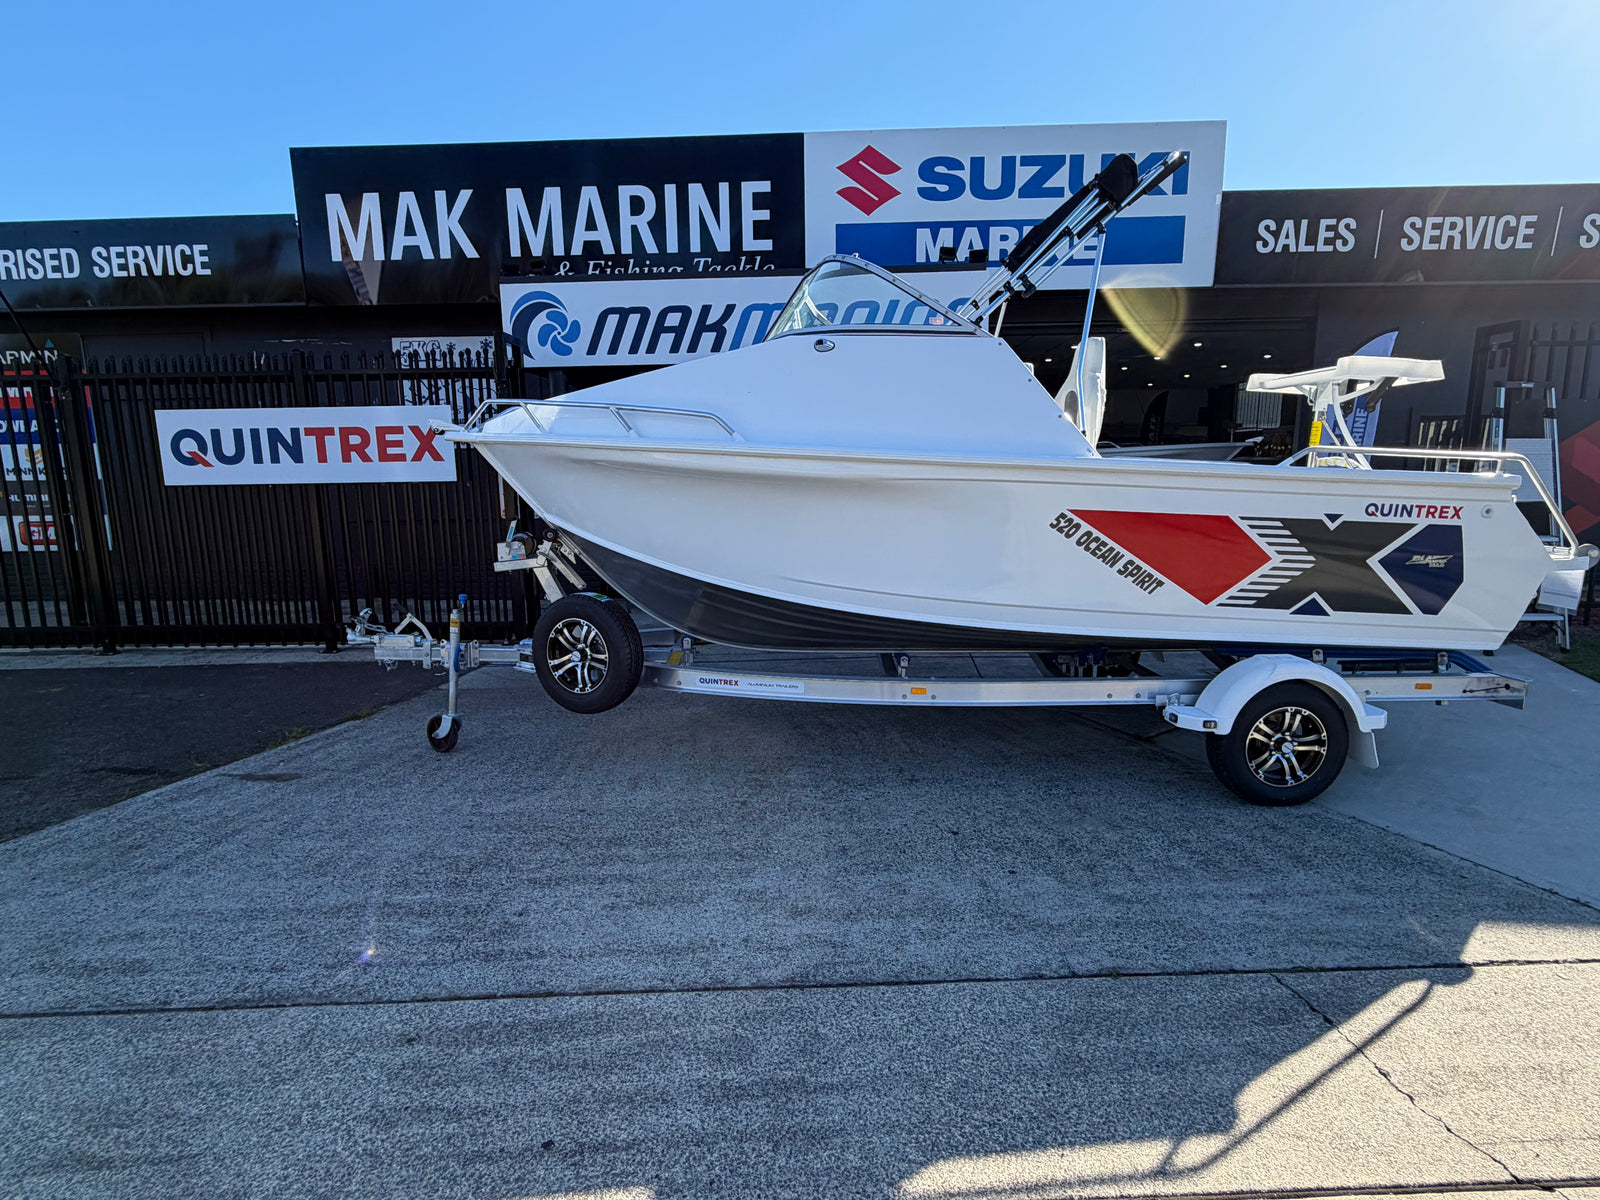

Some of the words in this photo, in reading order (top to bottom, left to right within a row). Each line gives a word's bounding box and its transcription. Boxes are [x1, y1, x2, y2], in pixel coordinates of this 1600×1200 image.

[325, 189, 480, 263] MAK
[505, 180, 774, 258] MARINE
[1255, 217, 1357, 254] SALES
[1400, 215, 1538, 252] SERVICE
[92, 244, 212, 279] SERVICE
[915, 222, 1099, 264] MARE
[170, 425, 445, 468] QUINTREX
[1364, 502, 1464, 520] QUINTREX
[1049, 512, 1082, 540] 520
[1075, 530, 1126, 569] OCEAN
[1116, 559, 1166, 595] SPIRIT
[699, 677, 739, 687] QUINTREX
